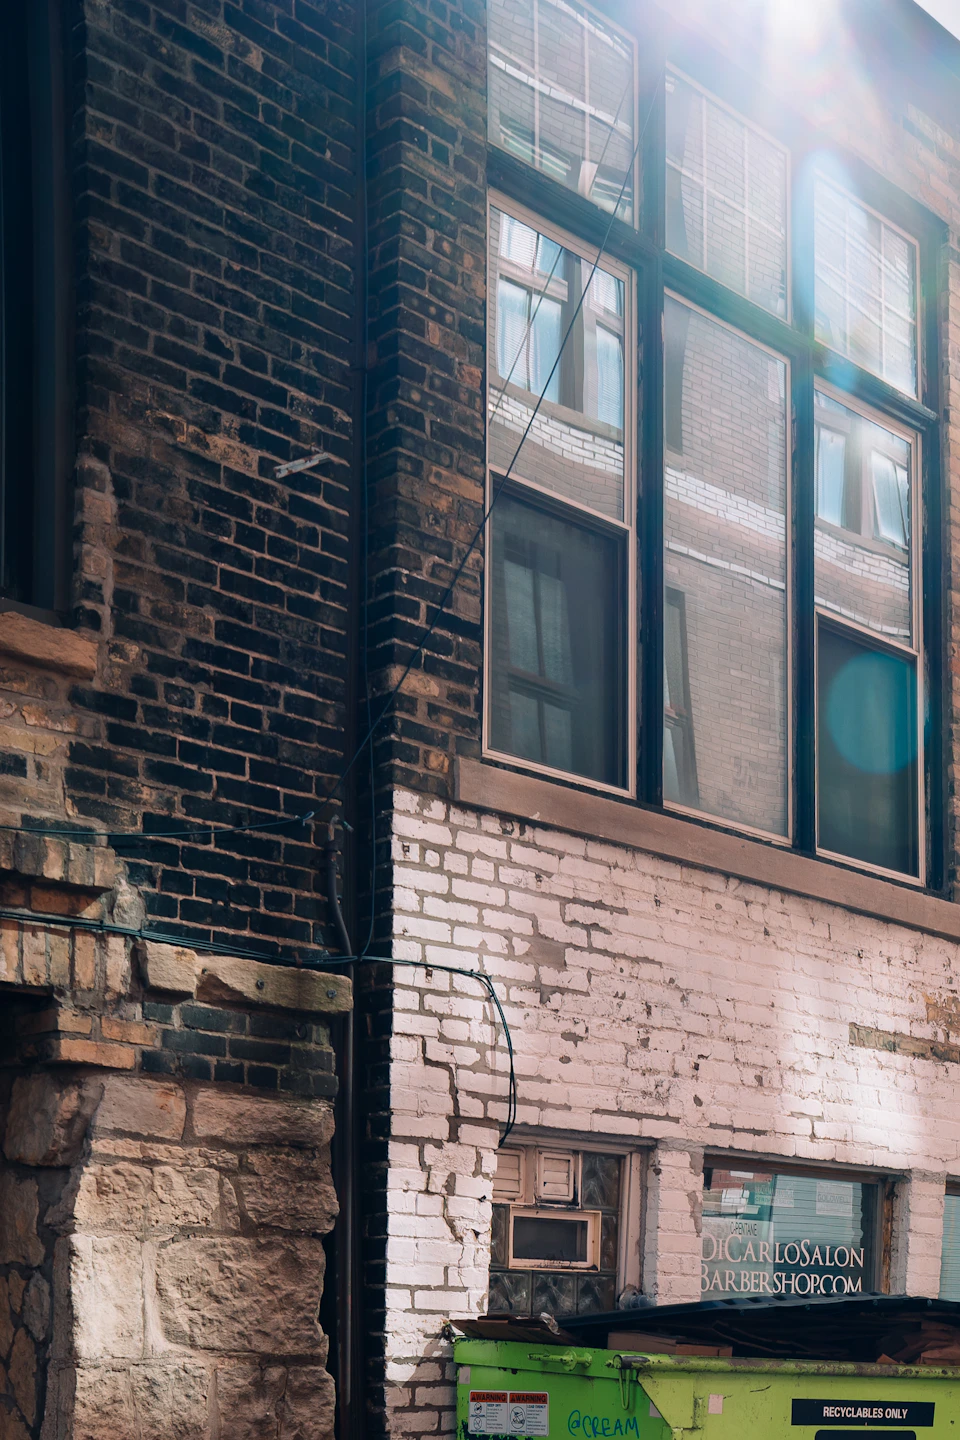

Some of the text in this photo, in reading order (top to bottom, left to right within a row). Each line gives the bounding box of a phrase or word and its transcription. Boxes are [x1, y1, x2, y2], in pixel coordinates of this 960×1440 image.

[475, 1393, 506, 1402] WARNING
[515, 1394, 547, 1403] WARNING
[823, 1406, 908, 1419] RECYCLABLES ONLY
[567, 1409, 640, 1439] @CREAM
